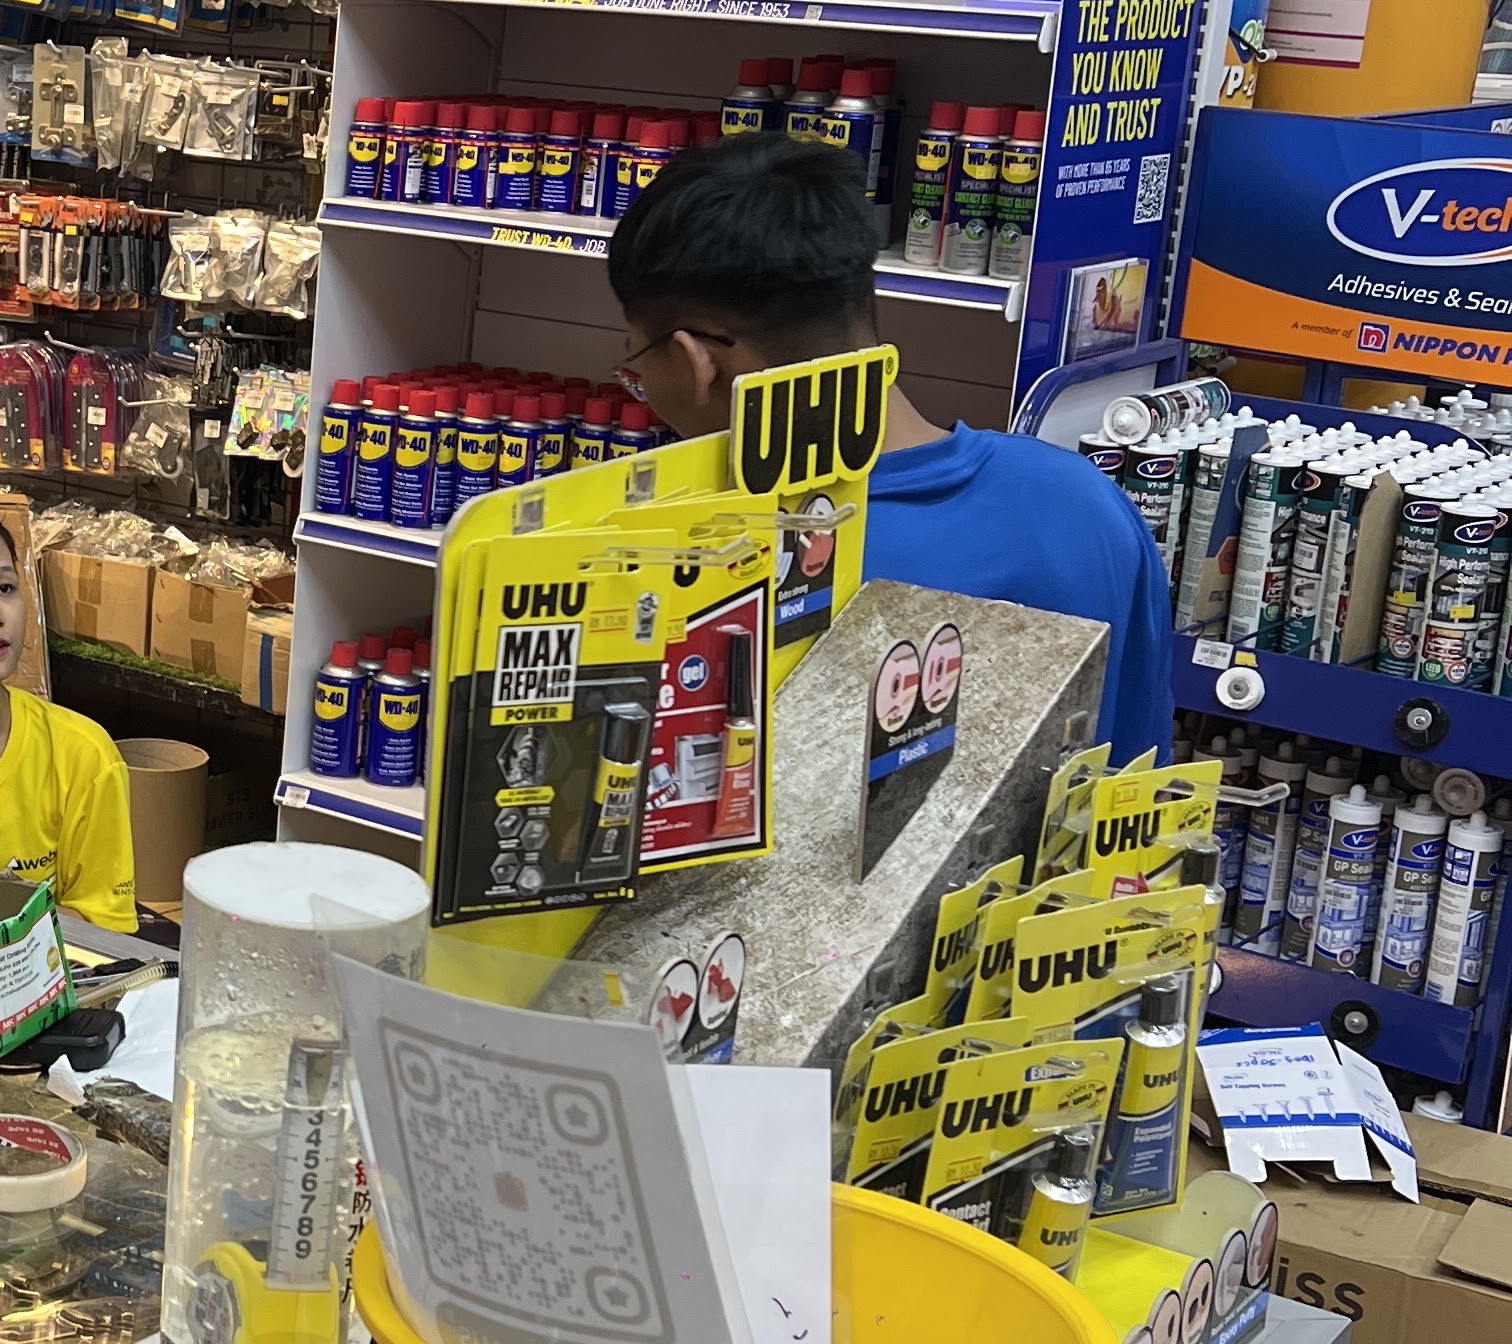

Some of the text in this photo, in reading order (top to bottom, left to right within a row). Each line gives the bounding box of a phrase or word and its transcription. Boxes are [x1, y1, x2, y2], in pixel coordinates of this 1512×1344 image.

[717, 0, 757, 16] SINCE
[760, 2, 790, 18] 1953
[1071, 48, 1163, 95] YOU KNOW
[724, 111, 758, 127] WD-40
[1061, 98, 1161, 147] AND TRUST
[1058, 165, 1073, 180] WITH
[1073, 163, 1089, 178] MORE
[1090, 161, 1105, 176] THAN
[1113, 158, 1131, 173] YEARS
[1055, 176, 1126, 198] OF PROVEN PERFORMANCE
[492, 226, 530, 243] TRUST
[580, 237, 606, 255] JOB
[1327, 272, 1462, 308] Adhesives &
[1291, 321, 1353, 339] A member of
[1393, 332, 1500, 366] NIPPON
[738, 359, 884, 495] UHU
[1439, 556, 1457, 569] High
[501, 582, 587, 620] UHU
[778, 584, 809, 602] Extra strong
[780, 599, 805, 619] Wood
[503, 628, 576, 669] MAX
[681, 662, 705, 684] gel
[499, 668, 570, 702] REPAIR
[505, 707, 559, 722] POWER
[888, 717, 943, 748] Strong long-lasting
[899, 741, 929, 765] Plastic
[1095, 810, 1161, 857] UHU
[1334, 860, 1349, 871] GP
[1403, 871, 1419, 883] GP
[1018, 941, 1117, 993] UHU
[864, 1068, 947, 1122] UHU
[941, 1087, 1033, 1138] UHU
[306, 1129, 322, 1147] 4
[303, 1151, 320, 1170] 5
[301, 1172, 318, 1192] 6
[299, 1194, 316, 1214] 7
[297, 1217, 314, 1237] 8
[295, 1239, 311, 1259] 9
[1238, 1305, 1257, 1326] Putty
